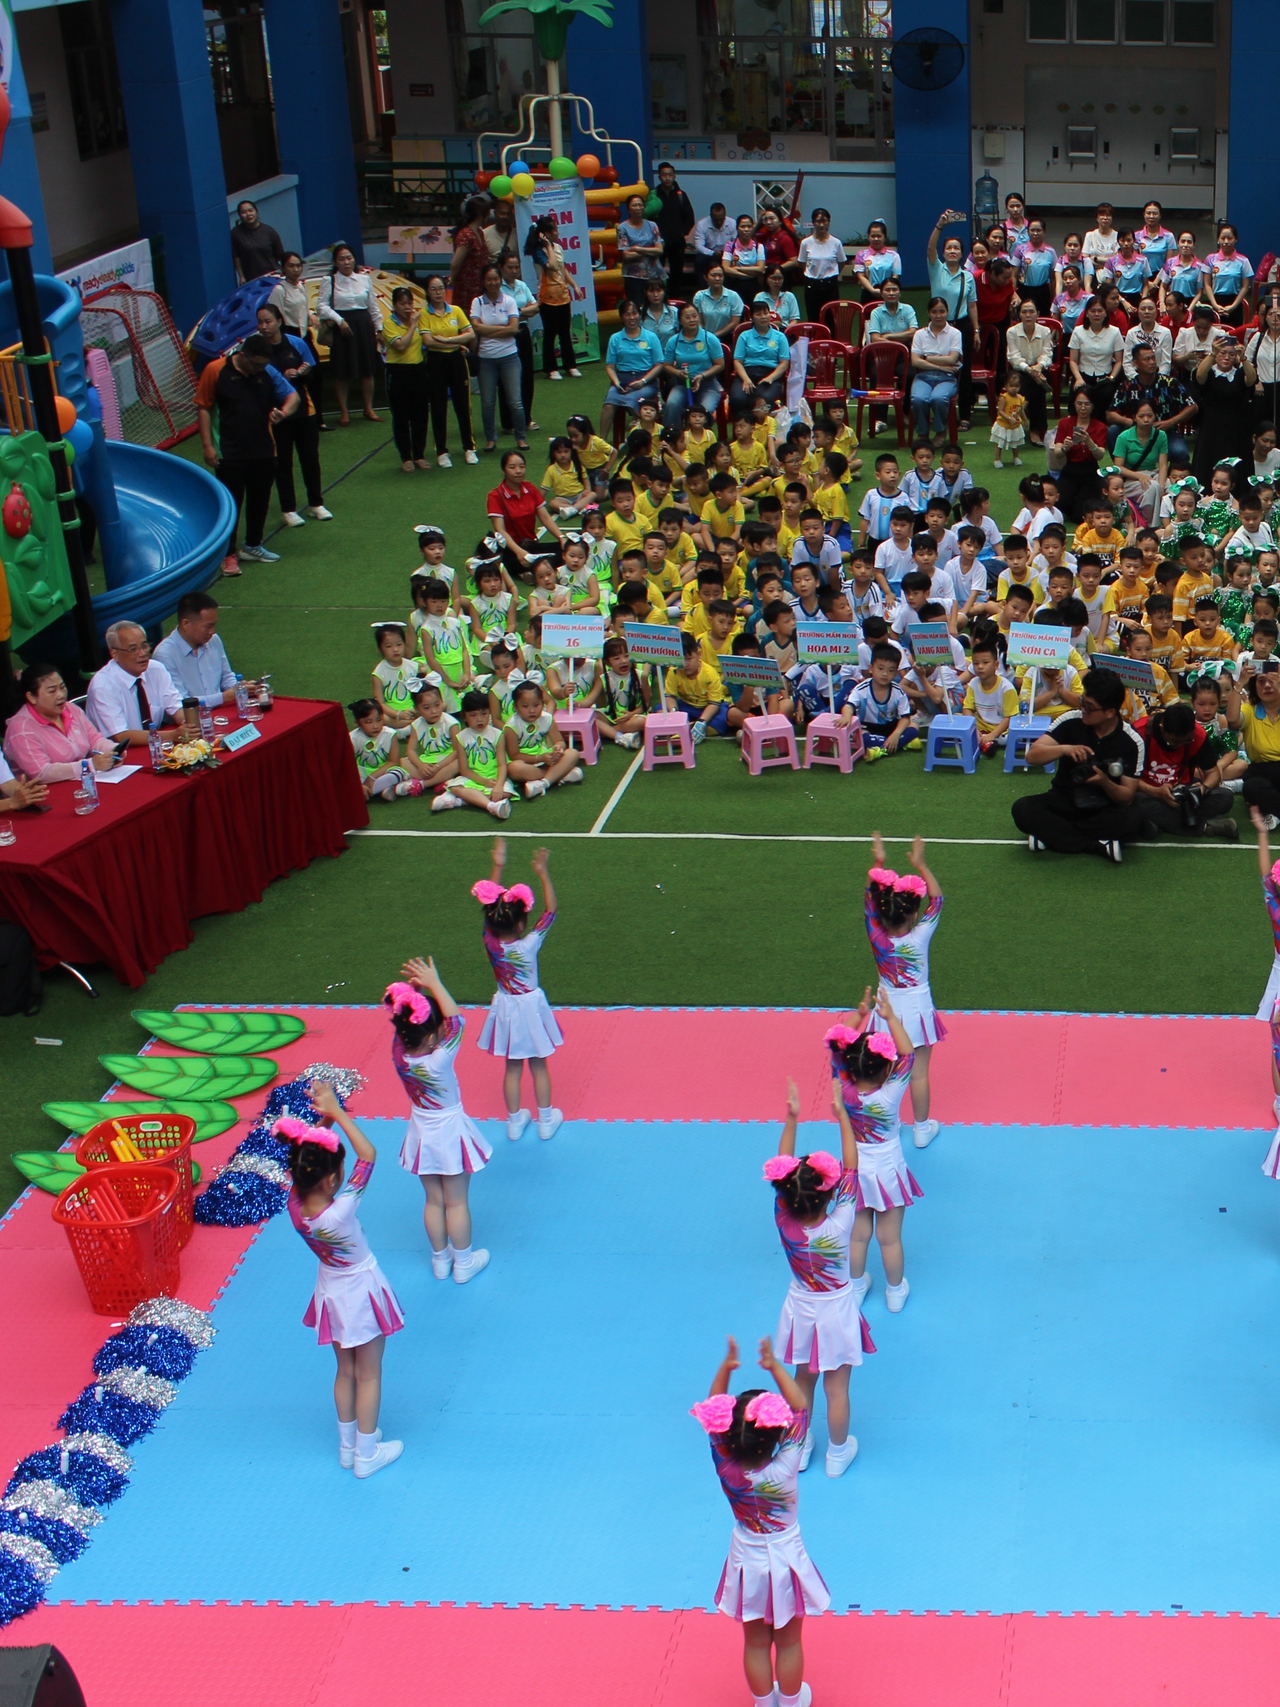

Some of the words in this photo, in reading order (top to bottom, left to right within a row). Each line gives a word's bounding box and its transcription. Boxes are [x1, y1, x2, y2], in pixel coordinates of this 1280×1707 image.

[565, 638, 580, 647] 16
[631, 644, 649, 654] ÁNH
[651, 647, 680, 657] DƯƠNG
[807, 645, 828, 654] HỌA
[917, 644, 935, 654] VÀNG
[935, 645, 949, 654] ANH
[1020, 645, 1040, 656] SƠN
[1043, 648, 1056, 657] CA
[726, 670, 747, 678] HÒA
[749, 670, 772, 680] BÌNH
